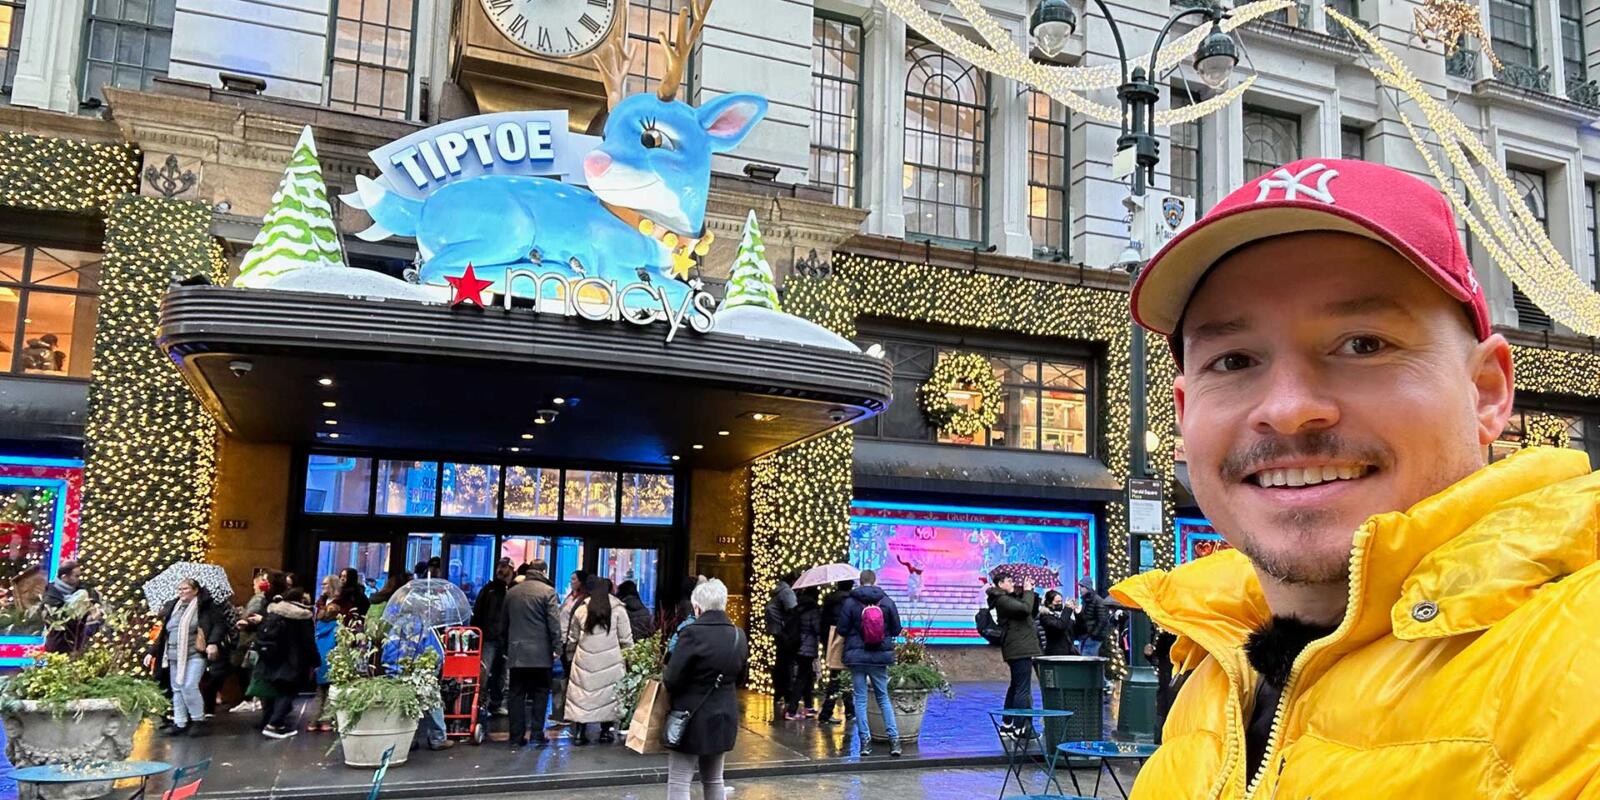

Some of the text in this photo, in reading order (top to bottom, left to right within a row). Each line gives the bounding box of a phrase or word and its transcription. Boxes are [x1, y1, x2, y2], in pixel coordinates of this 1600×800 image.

[390, 121, 554, 190] TIPTOE
[1255, 163, 1339, 204] NY
[917, 527, 937, 540] YOU
